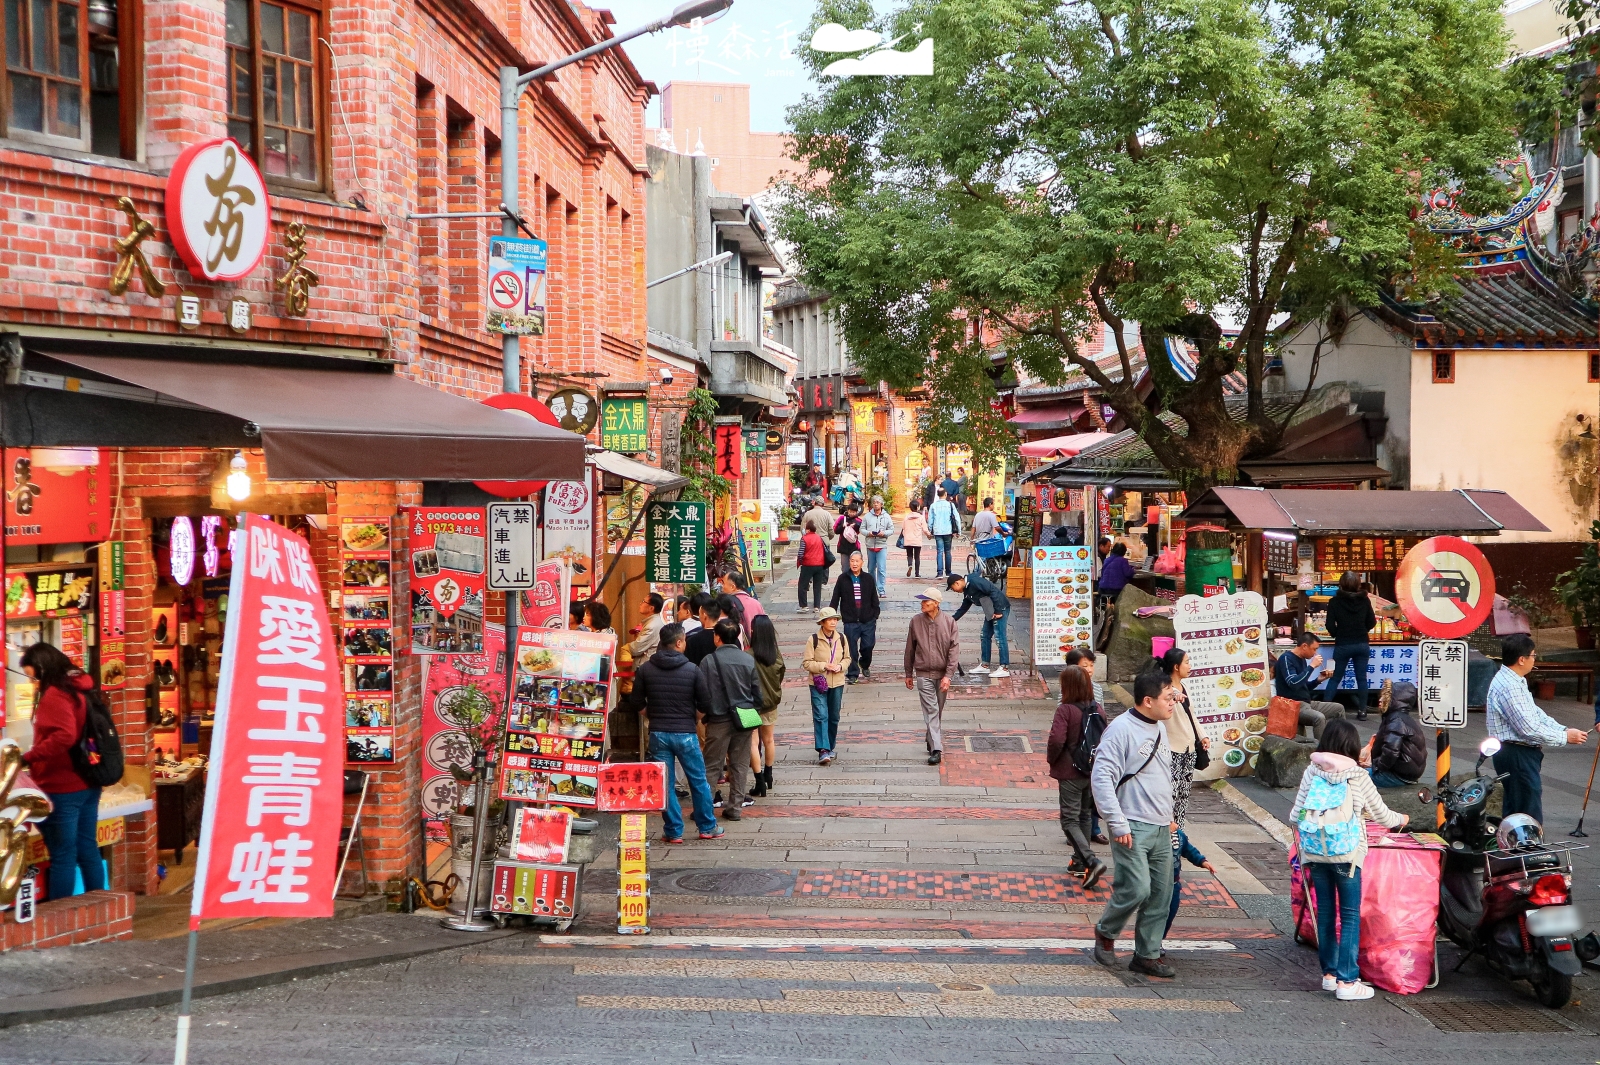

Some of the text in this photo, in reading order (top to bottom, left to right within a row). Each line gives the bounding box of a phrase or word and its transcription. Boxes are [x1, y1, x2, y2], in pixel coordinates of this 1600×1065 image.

[507, 242, 540, 254] 無菸街道
[180, 298, 252, 333] 豆腐
[604, 402, 645, 431] 金大鼎
[603, 434, 646, 451] 串烤香豆腐
[559, 483, 584, 509] 富發牌
[413, 510, 425, 535] 大春
[650, 504, 700, 521] 金大鼎
[22, 525, 41, 535] TOFU
[427, 523, 480, 534] 1973年創立
[494, 508, 511, 583] 汽車進入
[513, 508, 530, 583] 禁止
[653, 524, 671, 581] 搬來這裡
[679, 524, 697, 581] 正宗老店
[757, 540, 767, 567] 芋粿巧
[1325, 539, 1334, 560] 冷泡茶
[250, 525, 318, 594] 咪咪
[37, 574, 60, 592] 豆腐
[35, 593, 60, 611] 薯條
[1184, 598, 1244, 614] 味の豆腐
[522, 632, 542, 643] 感謝
[1424, 646, 1442, 722] 汽車進入
[1444, 646, 1462, 722] 禁止
[221, 596, 326, 905] 愛玉青蛙
[507, 756, 528, 768] 感謝
[564, 762, 597, 774] 媒體採訪
[604, 767, 659, 783] 豆腐薯條
[622, 903, 644, 917] 100
